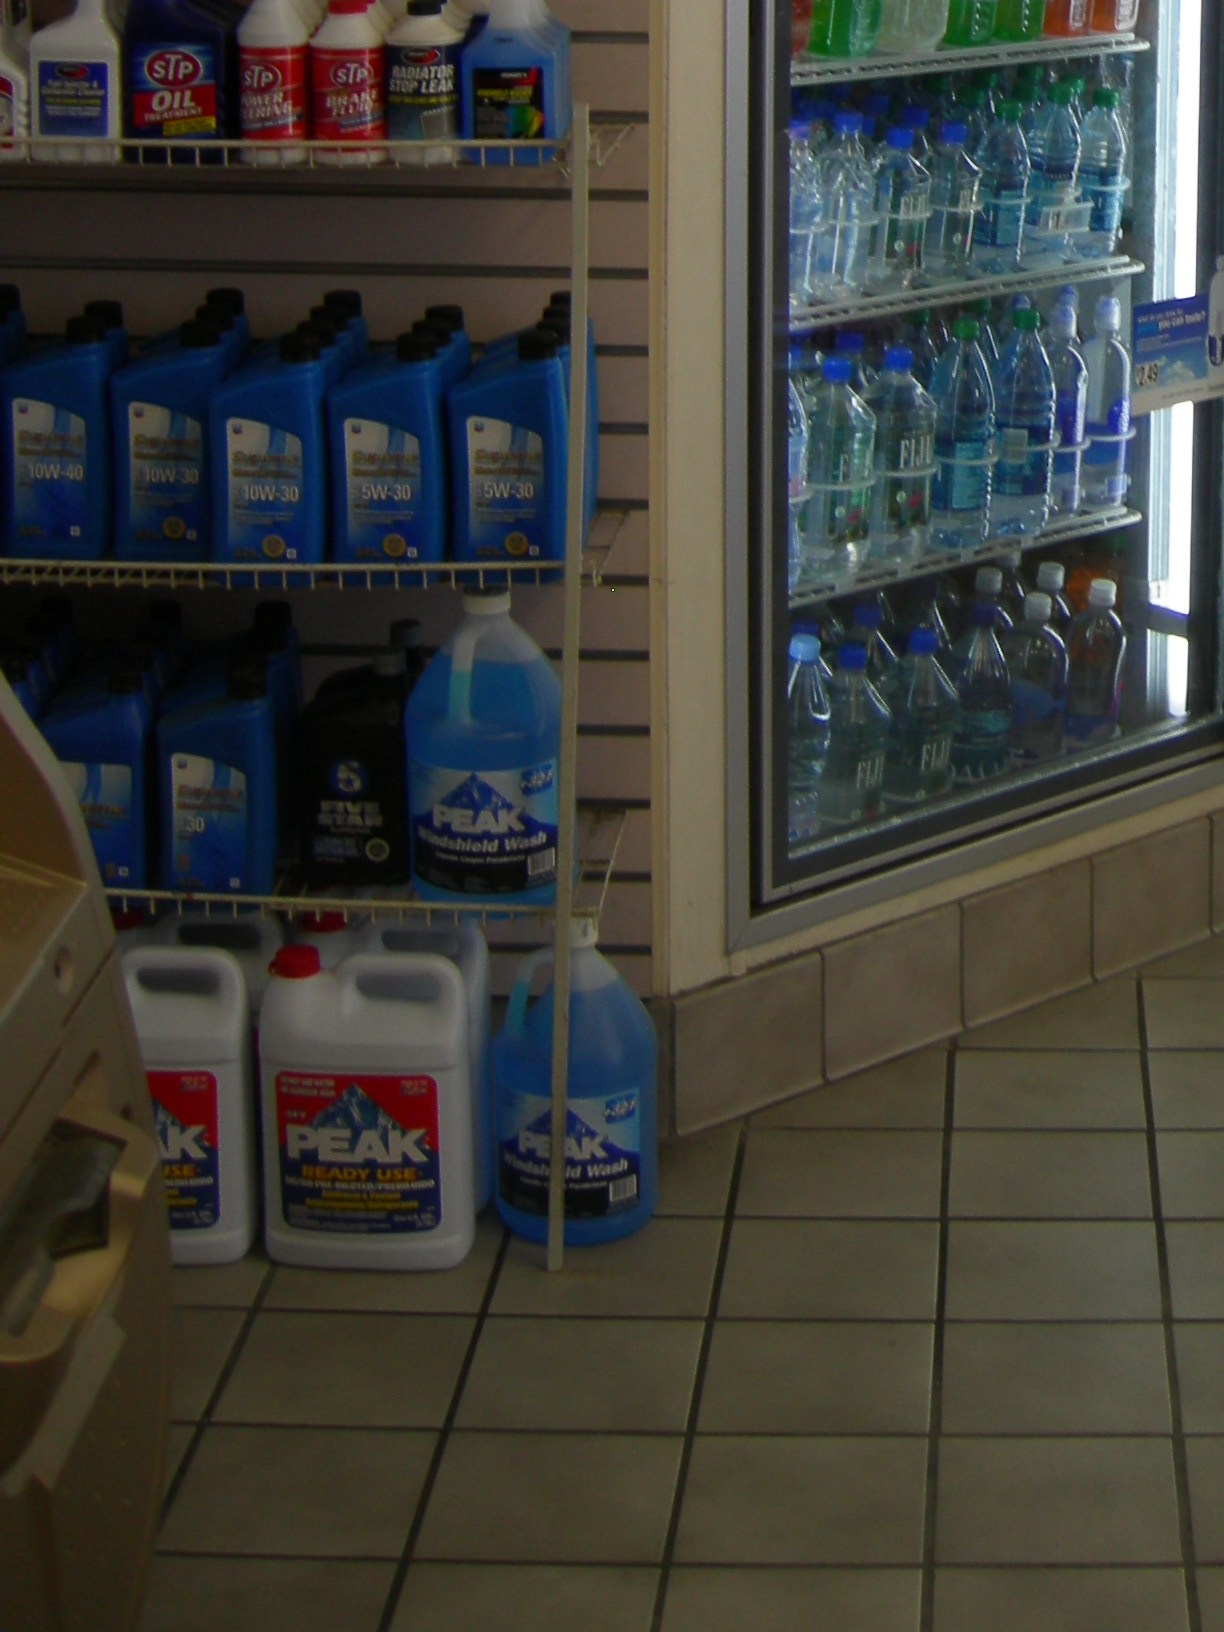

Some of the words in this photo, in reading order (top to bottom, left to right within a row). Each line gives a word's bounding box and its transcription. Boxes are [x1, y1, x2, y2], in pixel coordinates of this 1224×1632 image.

[153, 54, 194, 82] STP
[244, 65, 275, 88] STP
[337, 62, 369, 85] STP
[391, 64, 455, 81] RADIATOR
[389, 78, 418, 94] STOP
[420, 78, 455, 94] LEAK
[151, 88, 196, 112] OIL
[29, 462, 84, 482] 10W-40
[145, 466, 200, 485] 10W-30
[243, 484, 300, 503] 10W-30
[361, 483, 412, 501] 5W-30
[484, 482, 535, 500] 5W-30
[432, 802, 527, 836] PEAK
[418, 823, 500, 854] Windshield
[504, 830, 549, 852] Wash
[285, 1123, 430, 1164] PEAK
[302, 1165, 370, 1182] READY
[376, 1167, 418, 1182] USE
[503, 1149, 583, 1179] Windshld
[587, 1157, 629, 1179] Wash
